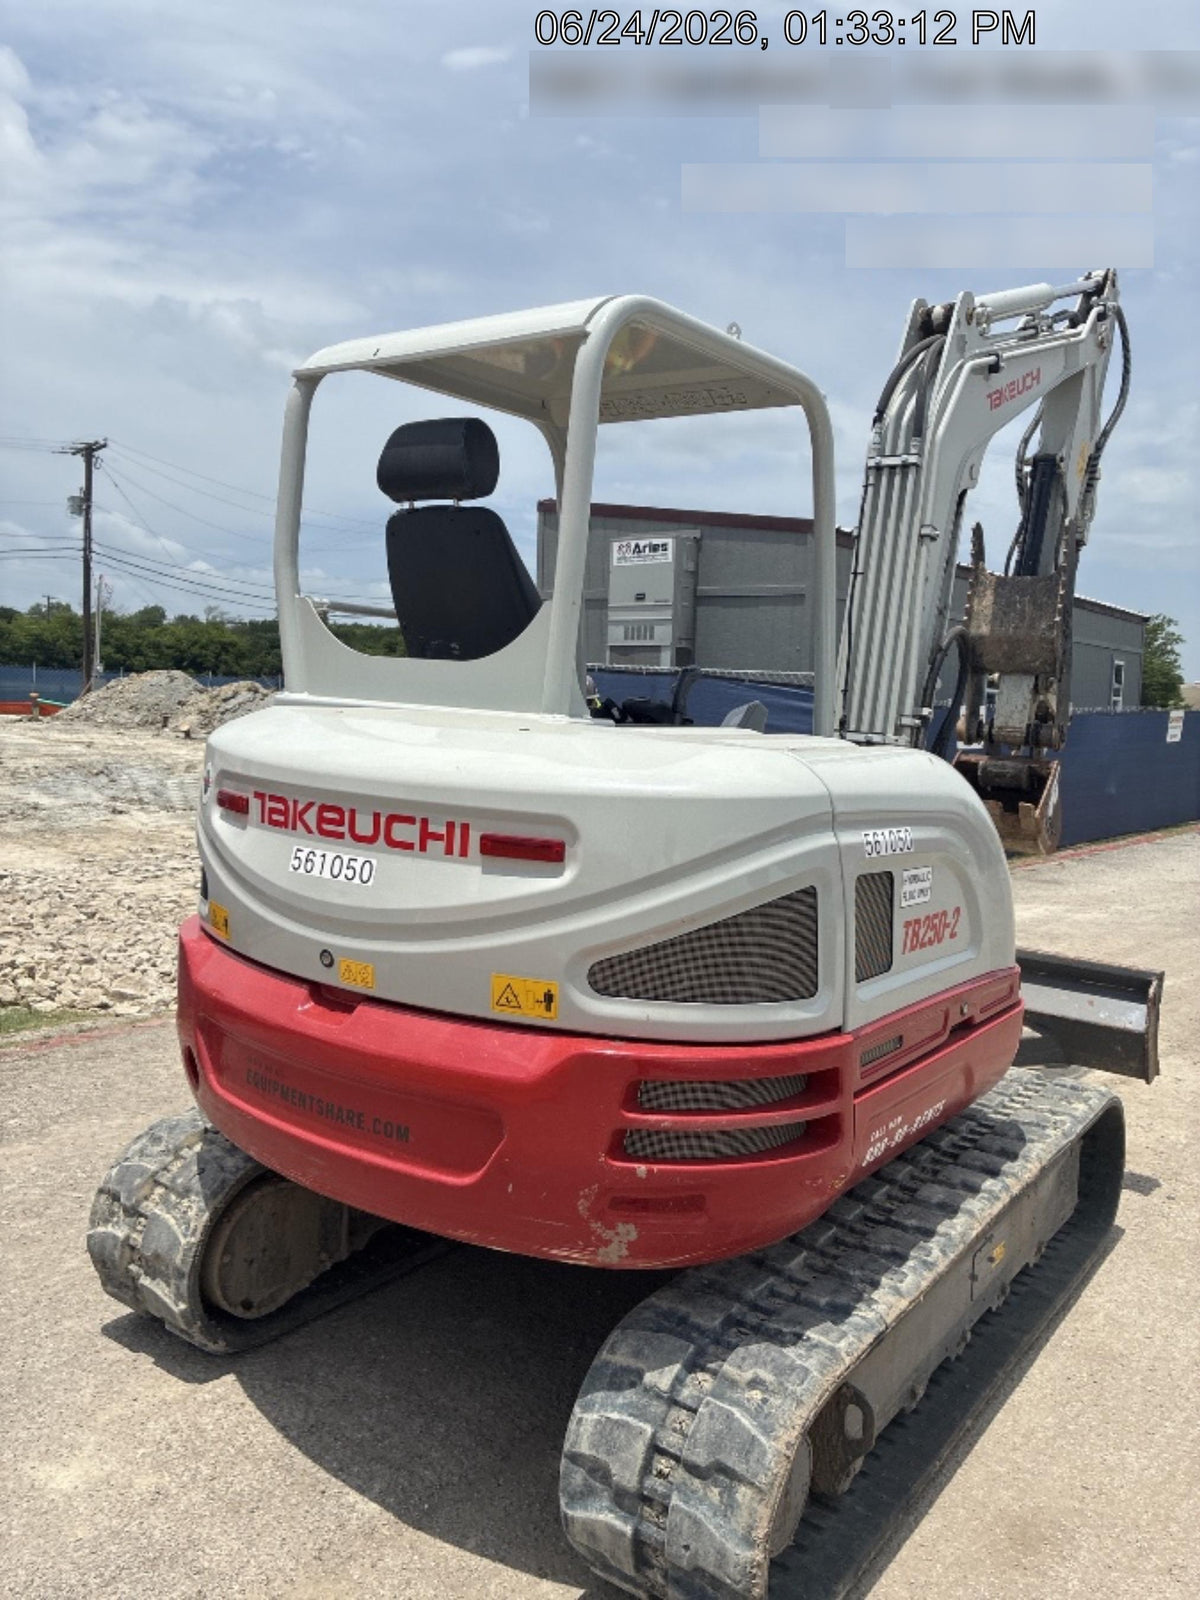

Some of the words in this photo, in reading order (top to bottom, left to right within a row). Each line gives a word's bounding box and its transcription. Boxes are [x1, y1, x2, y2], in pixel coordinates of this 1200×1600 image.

[633, 542, 669, 555] Aries
[863, 827, 914, 856] 561050
[290, 847, 375, 885] 561050
[901, 906, 961, 955] TB250-2
[246, 1068, 411, 1144] EQUIPMENTSHARE.COM
